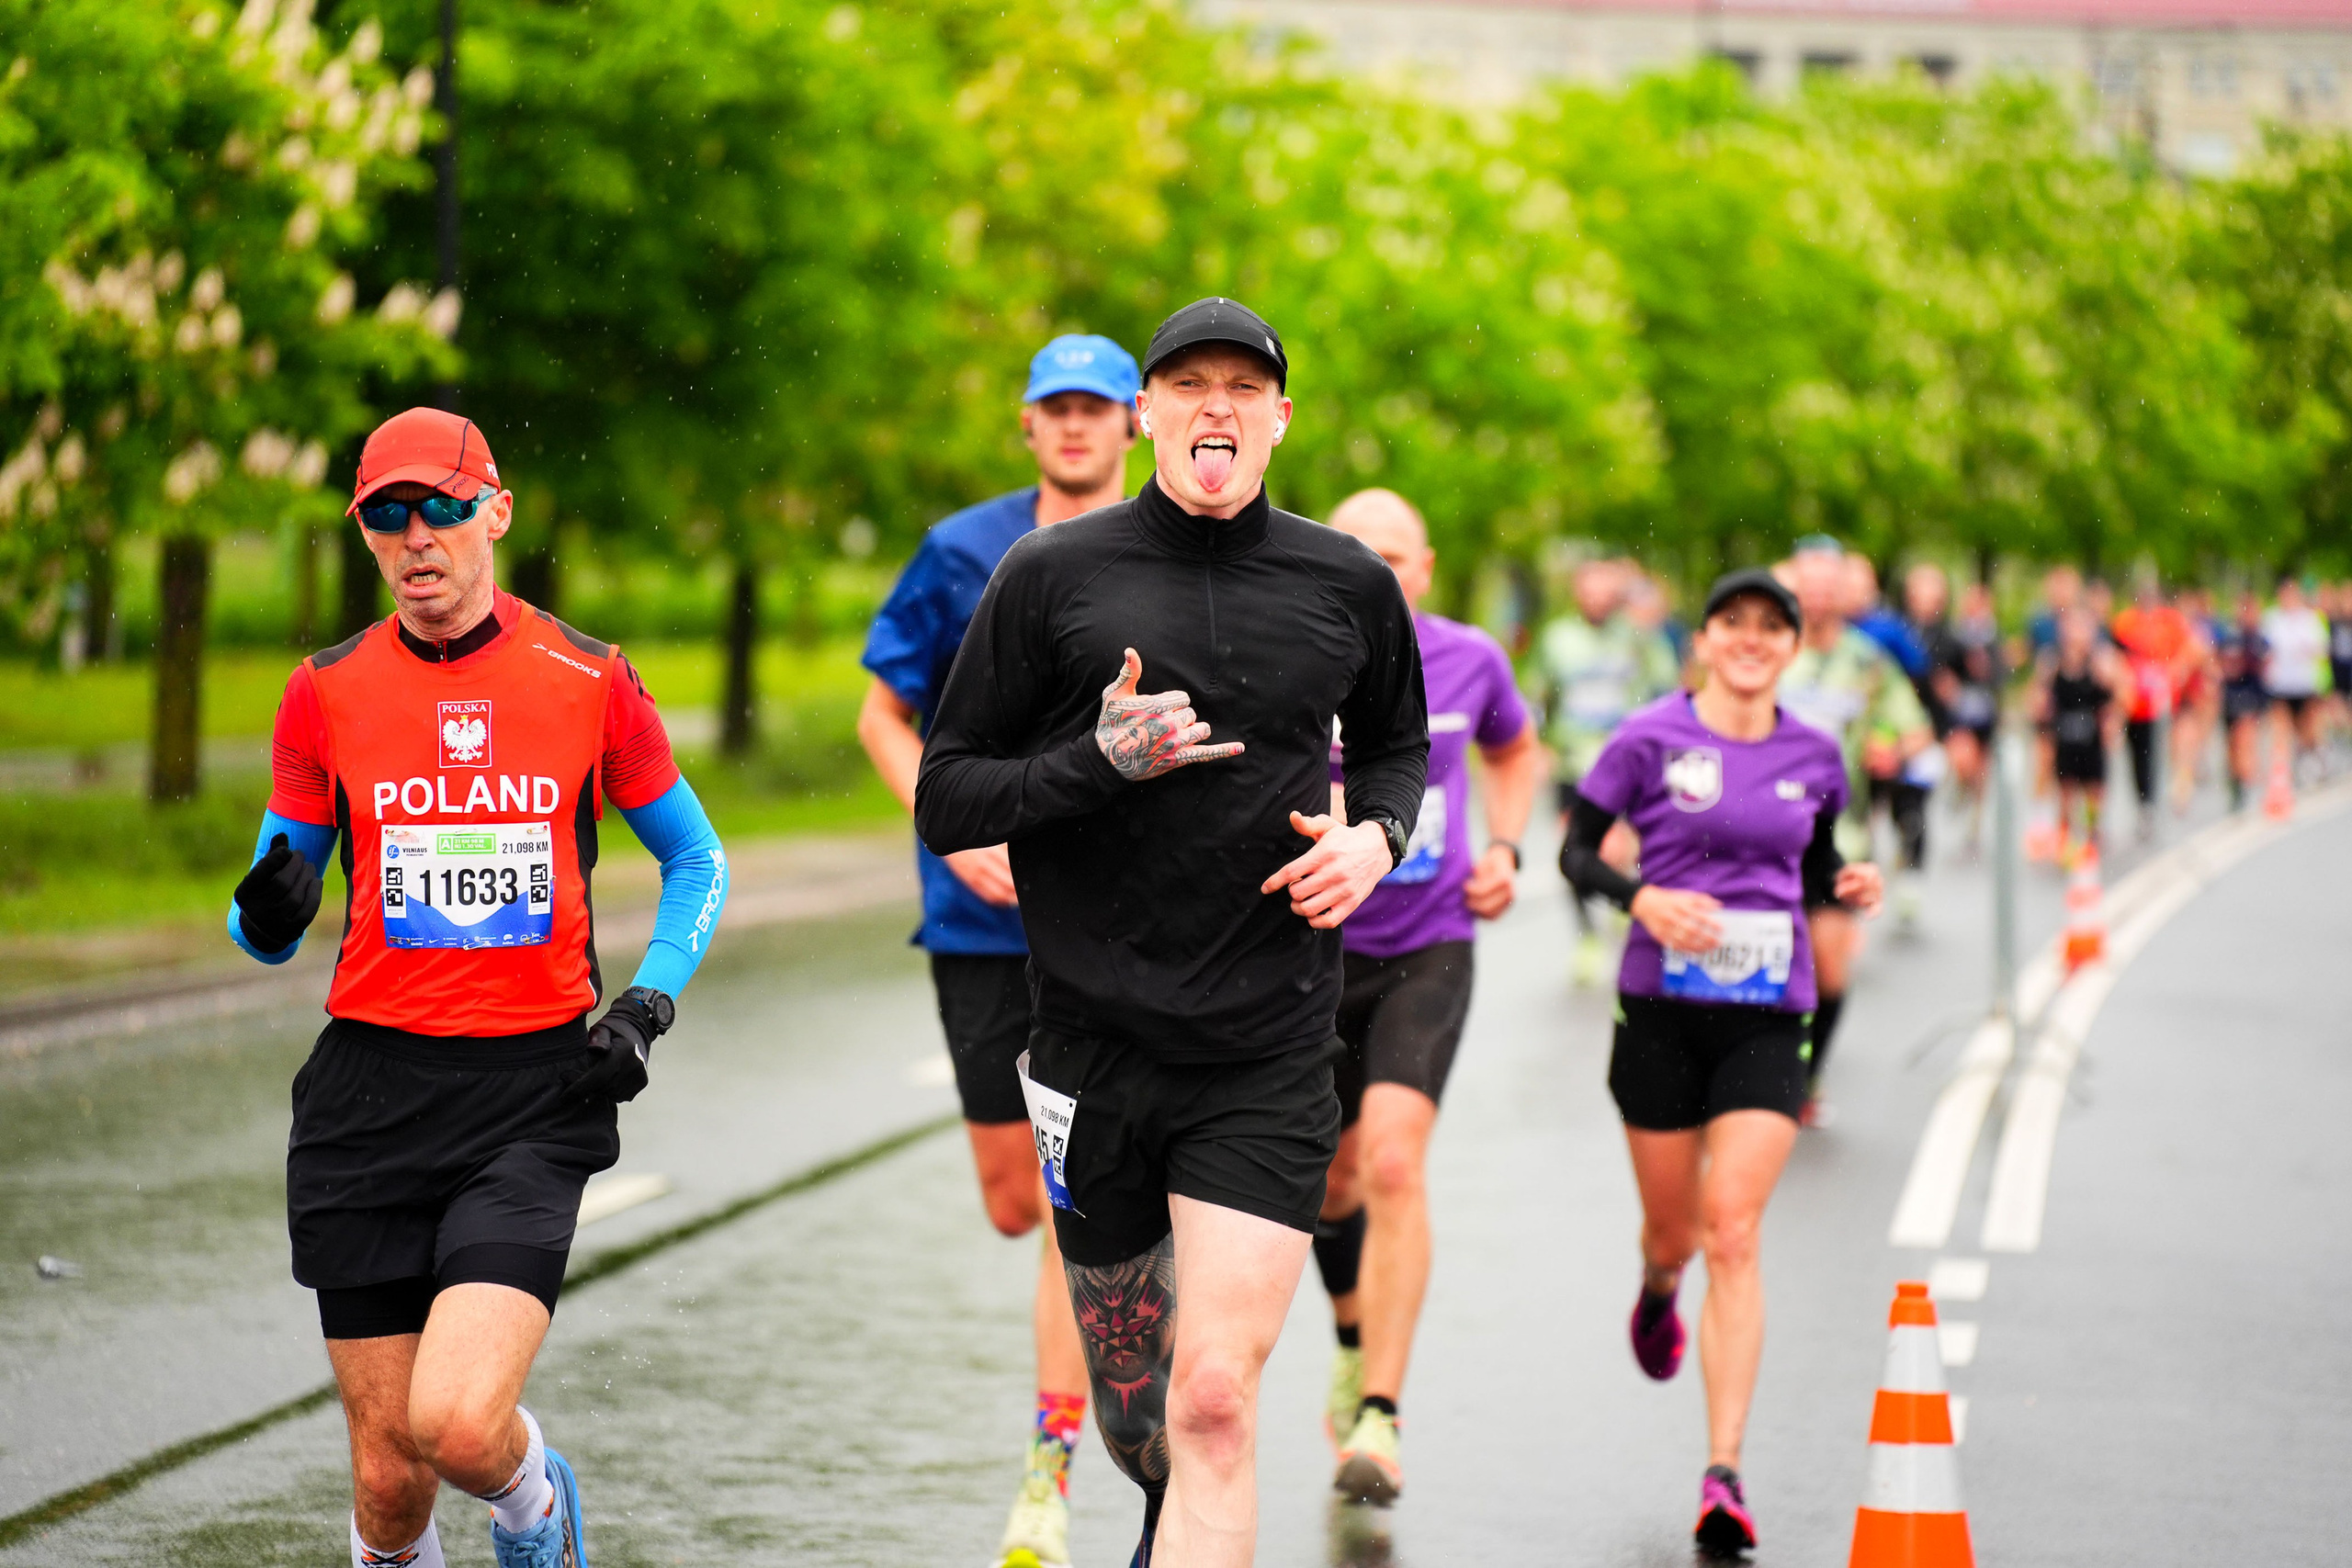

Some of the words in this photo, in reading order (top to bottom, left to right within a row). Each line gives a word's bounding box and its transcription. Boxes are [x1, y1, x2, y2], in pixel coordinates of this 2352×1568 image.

[548, 650, 602, 678] BROOKS
[442, 704, 487, 714] POLSKA
[374, 774, 560, 819] POLAND
[441, 839, 451, 850] A
[536, 840, 548, 852] KM
[419, 867, 518, 907] 11633
[695, 849, 725, 933] BROOKS
[1058, 1114, 1069, 1128] KM
[1030, 1118, 1049, 1165] 45
